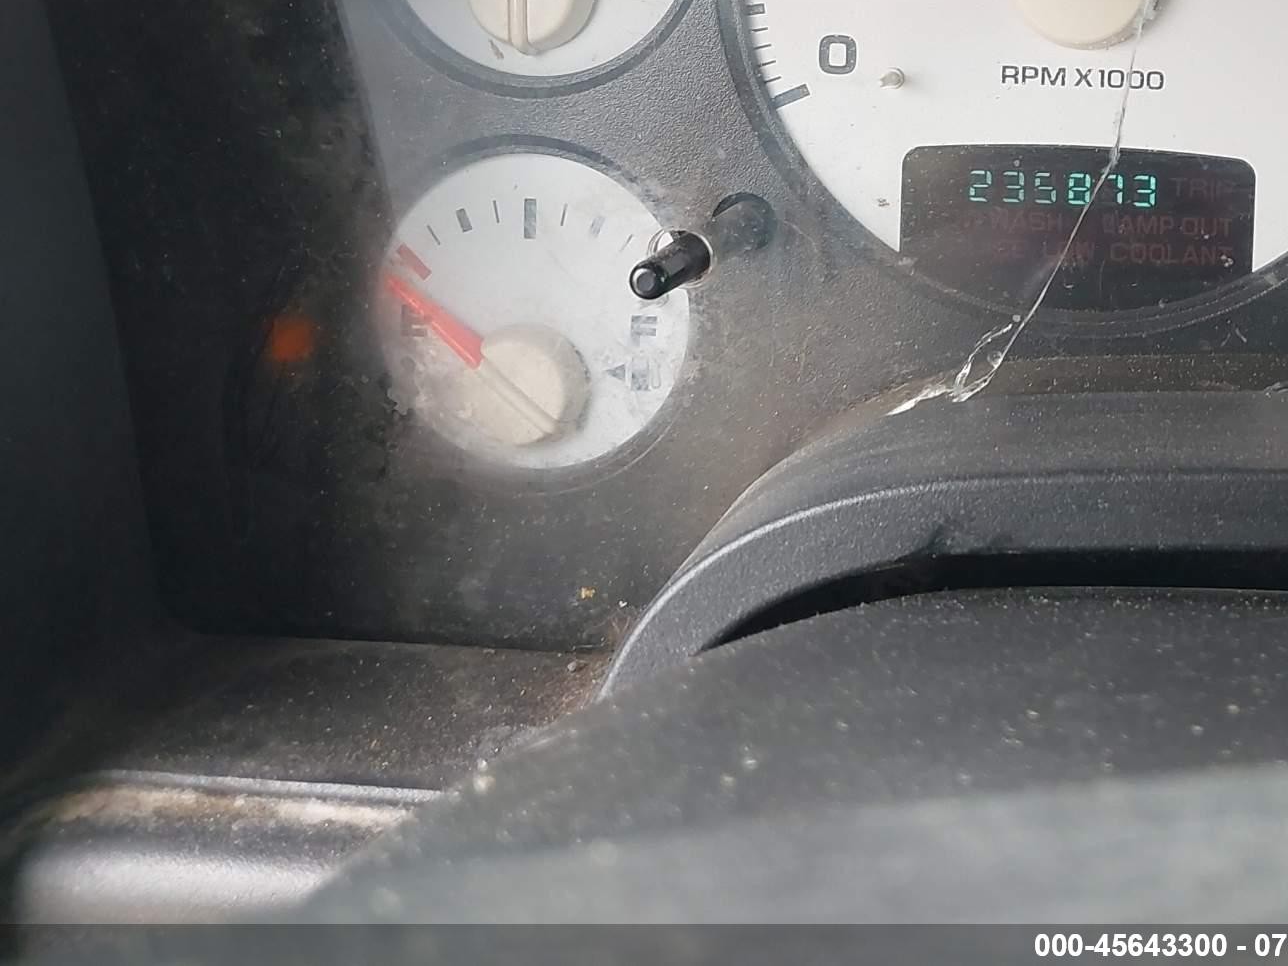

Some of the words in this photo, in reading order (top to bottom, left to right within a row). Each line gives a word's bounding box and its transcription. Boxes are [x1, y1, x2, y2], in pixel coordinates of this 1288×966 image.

[819, 35, 856, 74] 0
[1002, 66, 1066, 86] RPM
[969, 170, 1156, 207] 235873
[630, 315, 657, 346] F
